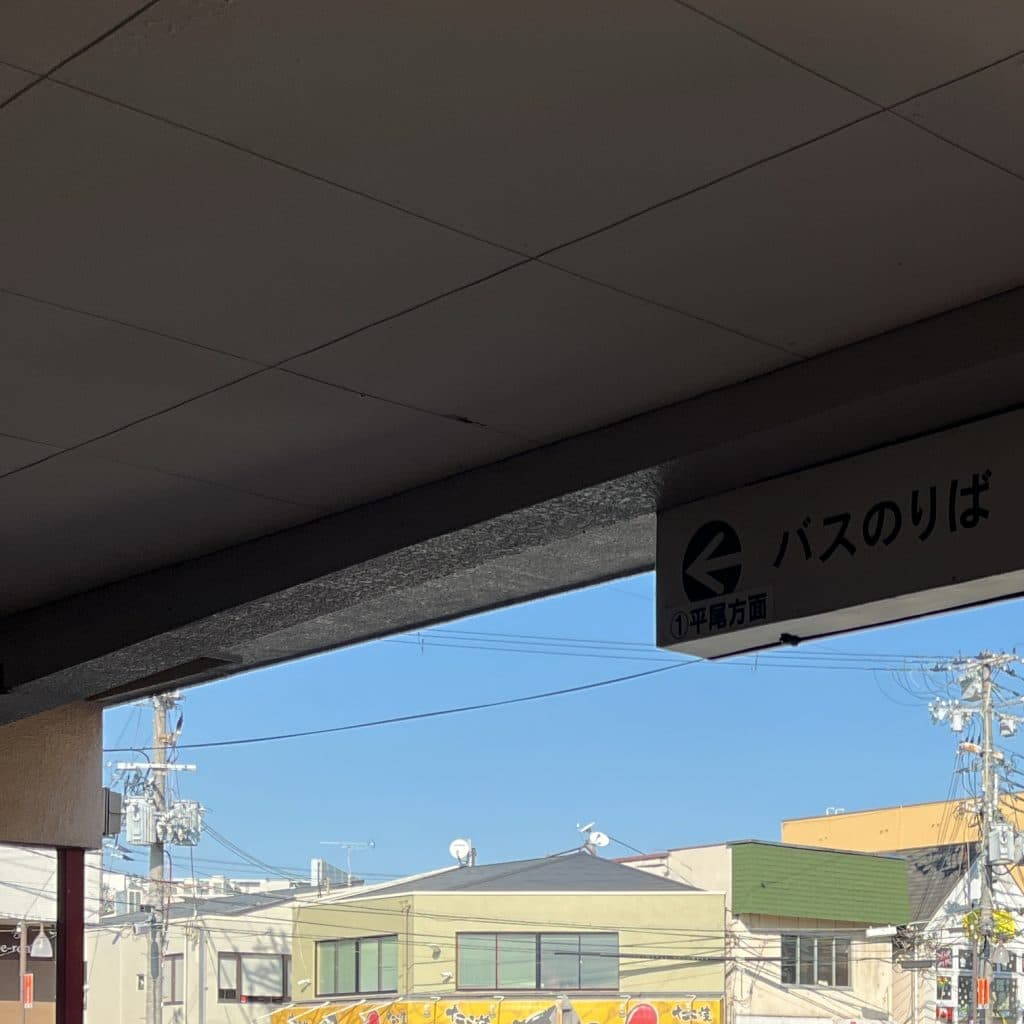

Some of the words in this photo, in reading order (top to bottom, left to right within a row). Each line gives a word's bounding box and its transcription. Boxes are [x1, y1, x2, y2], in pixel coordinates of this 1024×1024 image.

[772, 468, 993, 568] バスのりば
